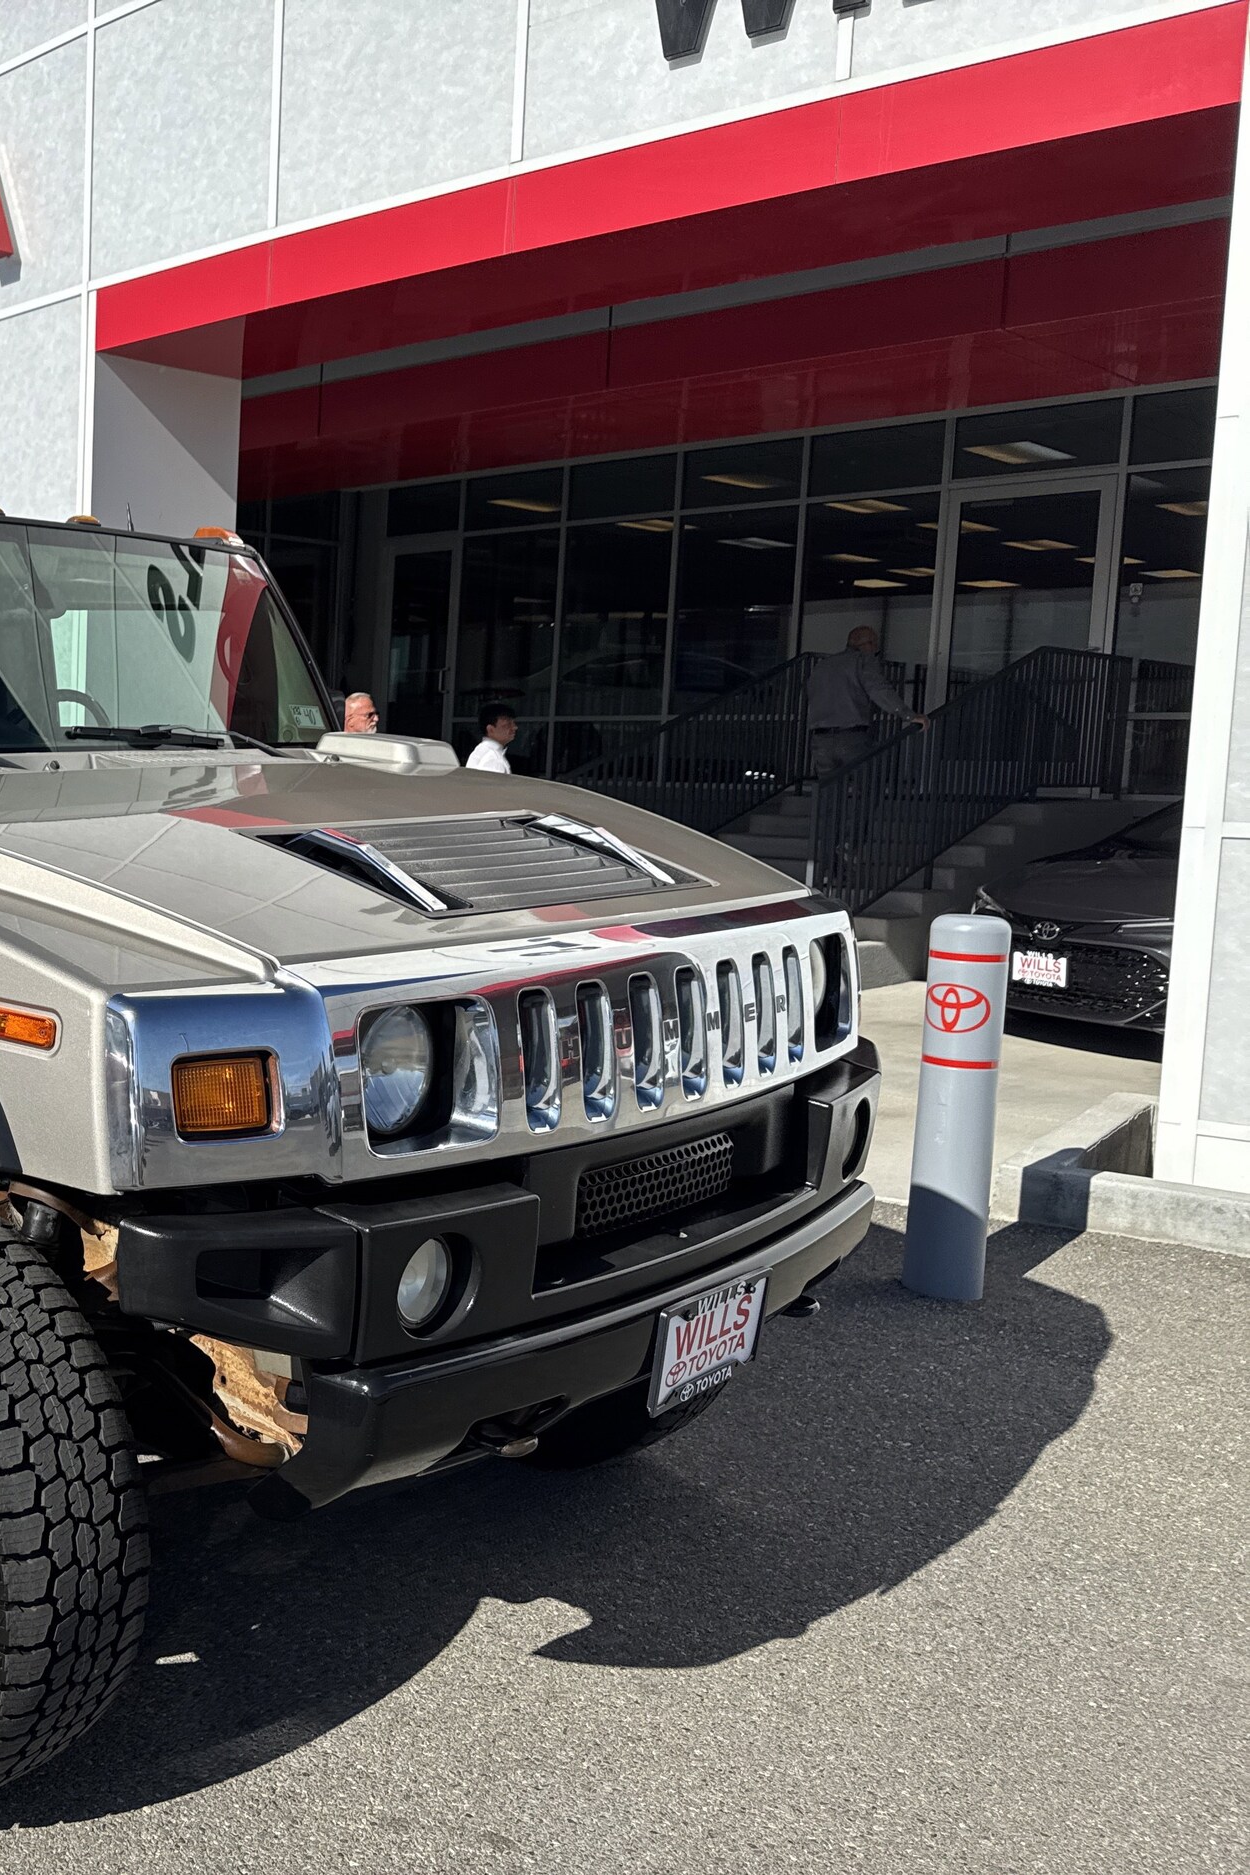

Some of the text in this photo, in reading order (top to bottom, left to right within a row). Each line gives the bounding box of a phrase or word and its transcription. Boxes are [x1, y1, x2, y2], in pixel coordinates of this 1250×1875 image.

[1020, 956, 1062, 974] WILLS
[1030, 970, 1062, 982] TOYOTA
[559, 994, 787, 1060] HUMMER
[698, 1281, 747, 1315] WILLS
[675, 1294, 753, 1361] WILLS
[688, 1331, 746, 1377] TOYOTA
[695, 1366, 733, 1394] TOYOTA
